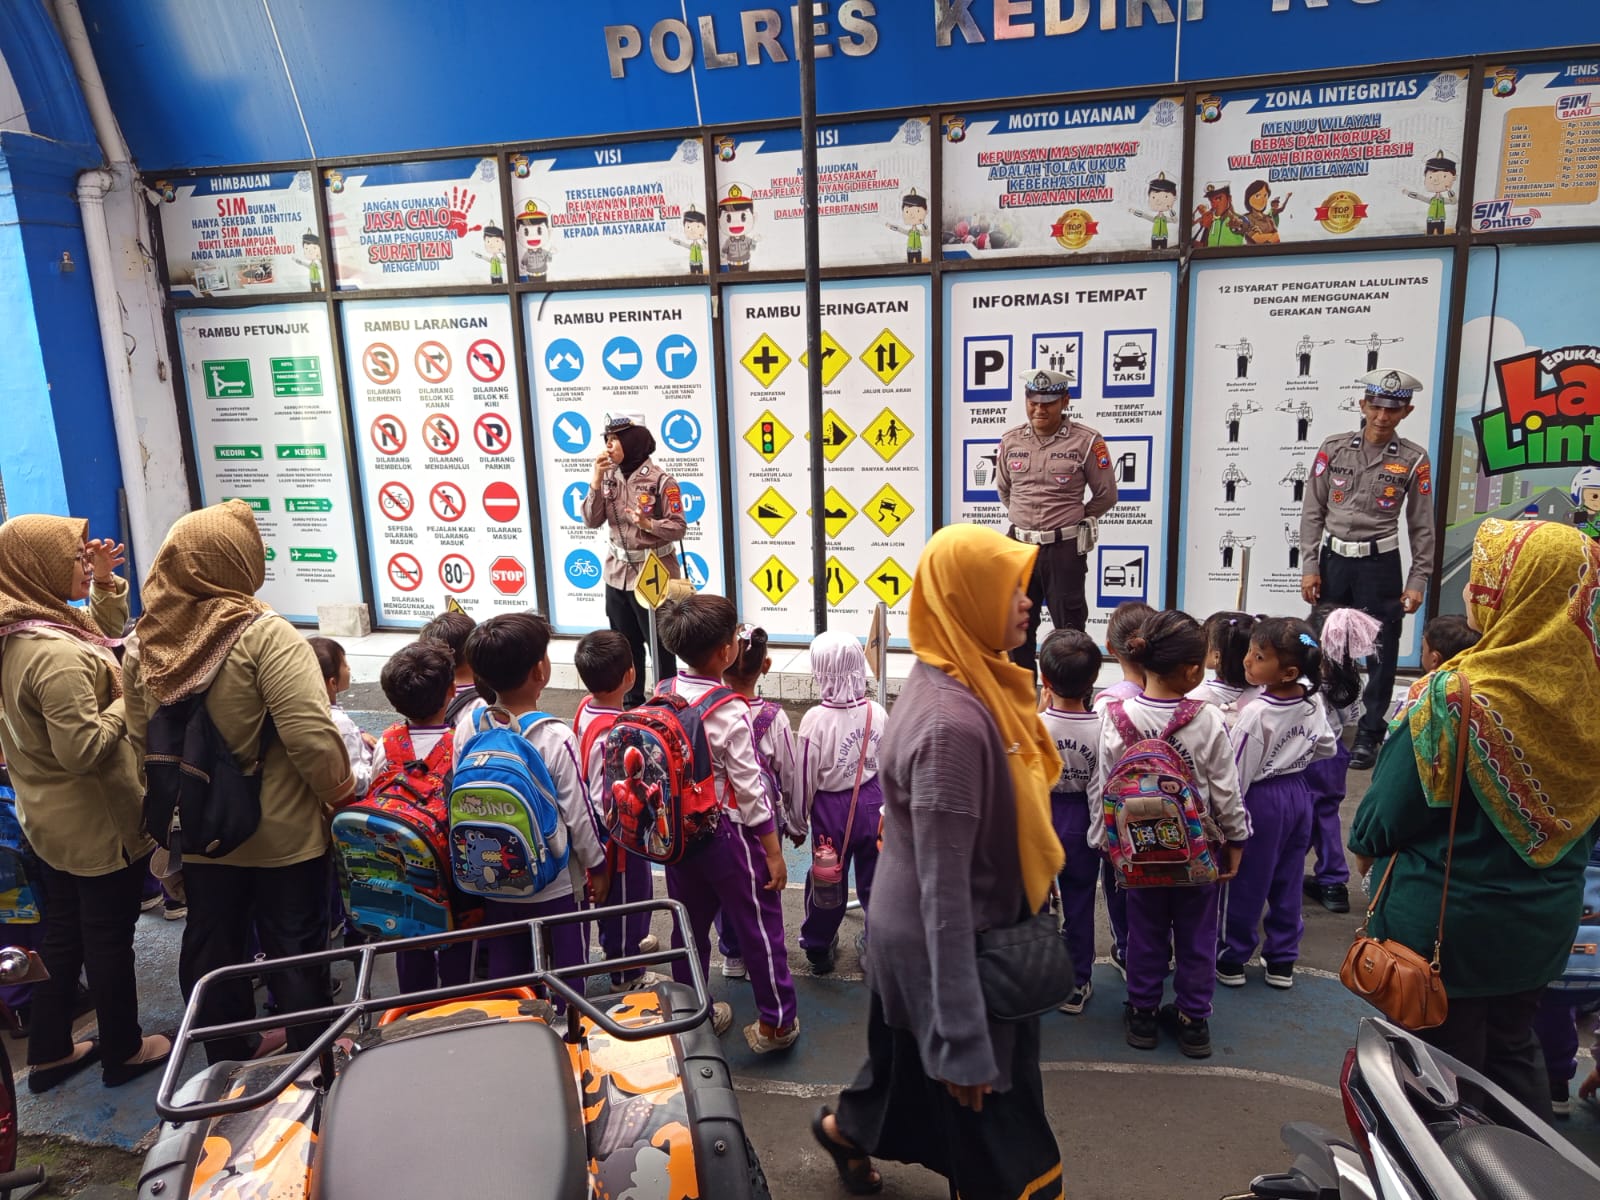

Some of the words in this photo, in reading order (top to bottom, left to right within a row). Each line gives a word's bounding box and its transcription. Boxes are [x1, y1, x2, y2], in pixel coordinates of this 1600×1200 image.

[604, 0, 879, 78] POLRES
[1564, 64, 1598, 76] JENIS
[1265, 91, 1312, 109] ZONA
[1318, 79, 1417, 103] INTEGRITAS
[1558, 94, 1588, 110] SIM
[1008, 111, 1059, 129] MOTTO
[1064, 105, 1135, 125] LAYANAN
[1563, 105, 1592, 118] BARU
[1261, 120, 1318, 137] MENUJU
[1319, 113, 1381, 131] WILAYAH
[1251, 137, 1295, 153] BEBAS
[1295, 134, 1330, 149] DARI
[1331, 128, 1391, 145] KORUPSI
[594, 149, 622, 165] VISI
[978, 148, 1050, 167] KEPUASAN
[1050, 141, 1140, 160] MASYARAKAT
[1228, 155, 1288, 170] WILAYAH
[1290, 148, 1363, 165] BIROKRASI
[1364, 142, 1414, 159] BERSIH
[819, 170, 877, 183] MASYARAKAT
[988, 164, 1041, 180] ADALAH
[1044, 160, 1086, 176] TOLAK
[1088, 157, 1126, 172] UKUR
[1269, 167, 1299, 182] DAN
[1300, 161, 1369, 180] MELAYANI
[210, 174, 271, 191] HIMBAUAN
[752, 189, 773, 200] ATAS
[826, 183, 850, 194] YANG
[851, 179, 899, 193] DIBERIKAN
[1007, 174, 1106, 192] KEBERHASILAN
[565, 183, 663, 200] TERSELENGGARANYA
[824, 194, 849, 204] POLRI
[999, 190, 1077, 209] PELAYANAN
[1078, 187, 1114, 204] KAMI
[217, 197, 247, 217] SIM
[248, 203, 276, 214] BUKAN
[362, 201, 399, 212] JANGAN
[401, 197, 448, 209] GUNAKAN
[566, 198, 627, 214] PELAYANAN
[629, 195, 665, 208] PRIMA
[862, 202, 878, 213] SIM
[1473, 202, 1509, 219] SIM
[192, 219, 219, 229] HANYA
[222, 216, 256, 226] SEKEDAR
[261, 212, 302, 223] IDENTITAS
[363, 211, 406, 233] JASA
[406, 207, 452, 230] CALO
[551, 213, 587, 227] DALAM
[589, 208, 655, 225] PENERBITAN
[659, 206, 681, 219] SIM
[1480, 215, 1532, 230] Online
[201, 230, 219, 240] TAPI
[221, 227, 239, 238] SIM
[242, 226, 273, 237] ADALAH
[360, 233, 392, 245] DALAM
[394, 230, 457, 243] PENGURUSAN
[563, 226, 599, 239] KEPADA
[603, 222, 666, 236] MASYARAKAT
[198, 240, 221, 250] BUKTI
[223, 236, 276, 248] KEMAMPUAN
[191, 250, 213, 260] ANDA
[215, 248, 242, 258] DALAM
[245, 245, 295, 256] MENGEMUDI
[368, 243, 418, 264] SURAT
[420, 240, 453, 261] IZIN
[383, 261, 439, 273] MENGEMUDI
[1218, 286, 1231, 294] 12
[1233, 283, 1278, 293] ISYARAT
[1282, 280, 1356, 291] PENGATURAN
[1359, 276, 1428, 287] LALULINTAS
[973, 291, 1069, 309] INFORMASI
[1076, 288, 1148, 304] TEMPAT
[1253, 295, 1298, 305] DENGAN
[1302, 291, 1389, 303] MENGGUNAKAN
[554, 313, 604, 325] RAMBU
[609, 309, 682, 322] PERINTAH
[746, 305, 800, 319] RAMBU
[819, 300, 909, 316] ERINGATAN
[1269, 307, 1322, 317] GERAKAN
[1325, 305, 1371, 315] TANGAN
[199, 326, 240, 338] RAMBU
[244, 323, 309, 336] PETUNJUK
[364, 320, 410, 332] RAMBU
[414, 317, 488, 330] LARANGAN
[975, 350, 1004, 385] P
[1113, 373, 1146, 382] TAKSI
[970, 407, 1008, 416] TEMPAT
[1096, 410, 1162, 418] PEMBERHENTIAN
[1114, 403, 1144, 411] TEMPAT
[295, 448, 321, 456] KEDIRI
[1050, 452, 1077, 460] POLRI
[444, 563, 463, 584] 80
[492, 571, 524, 581] STOP
